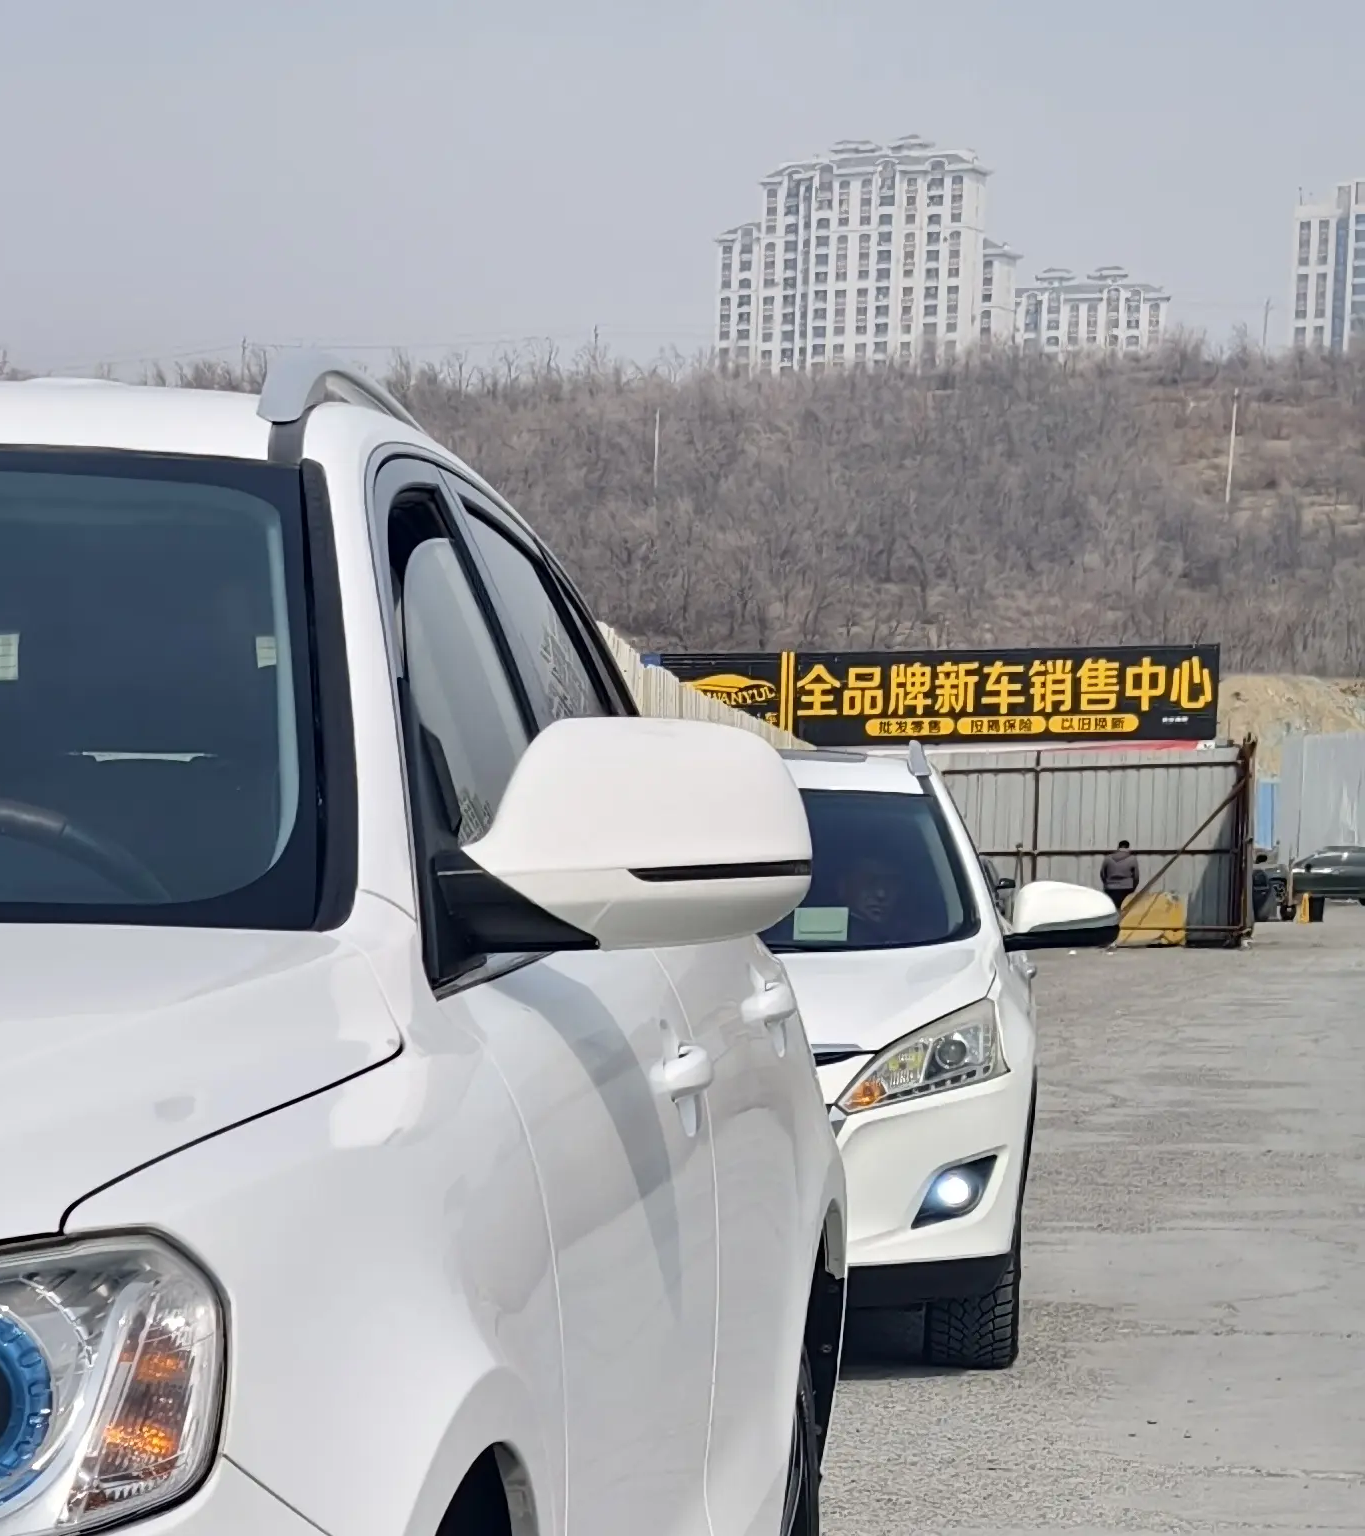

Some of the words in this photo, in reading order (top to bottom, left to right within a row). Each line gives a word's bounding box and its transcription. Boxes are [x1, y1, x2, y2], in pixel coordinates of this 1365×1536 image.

[796, 656, 1212, 716] 全品牌新车销售中心
[878, 719, 941, 734] 批发零售
[1060, 717, 1126, 731] 以旧换新
